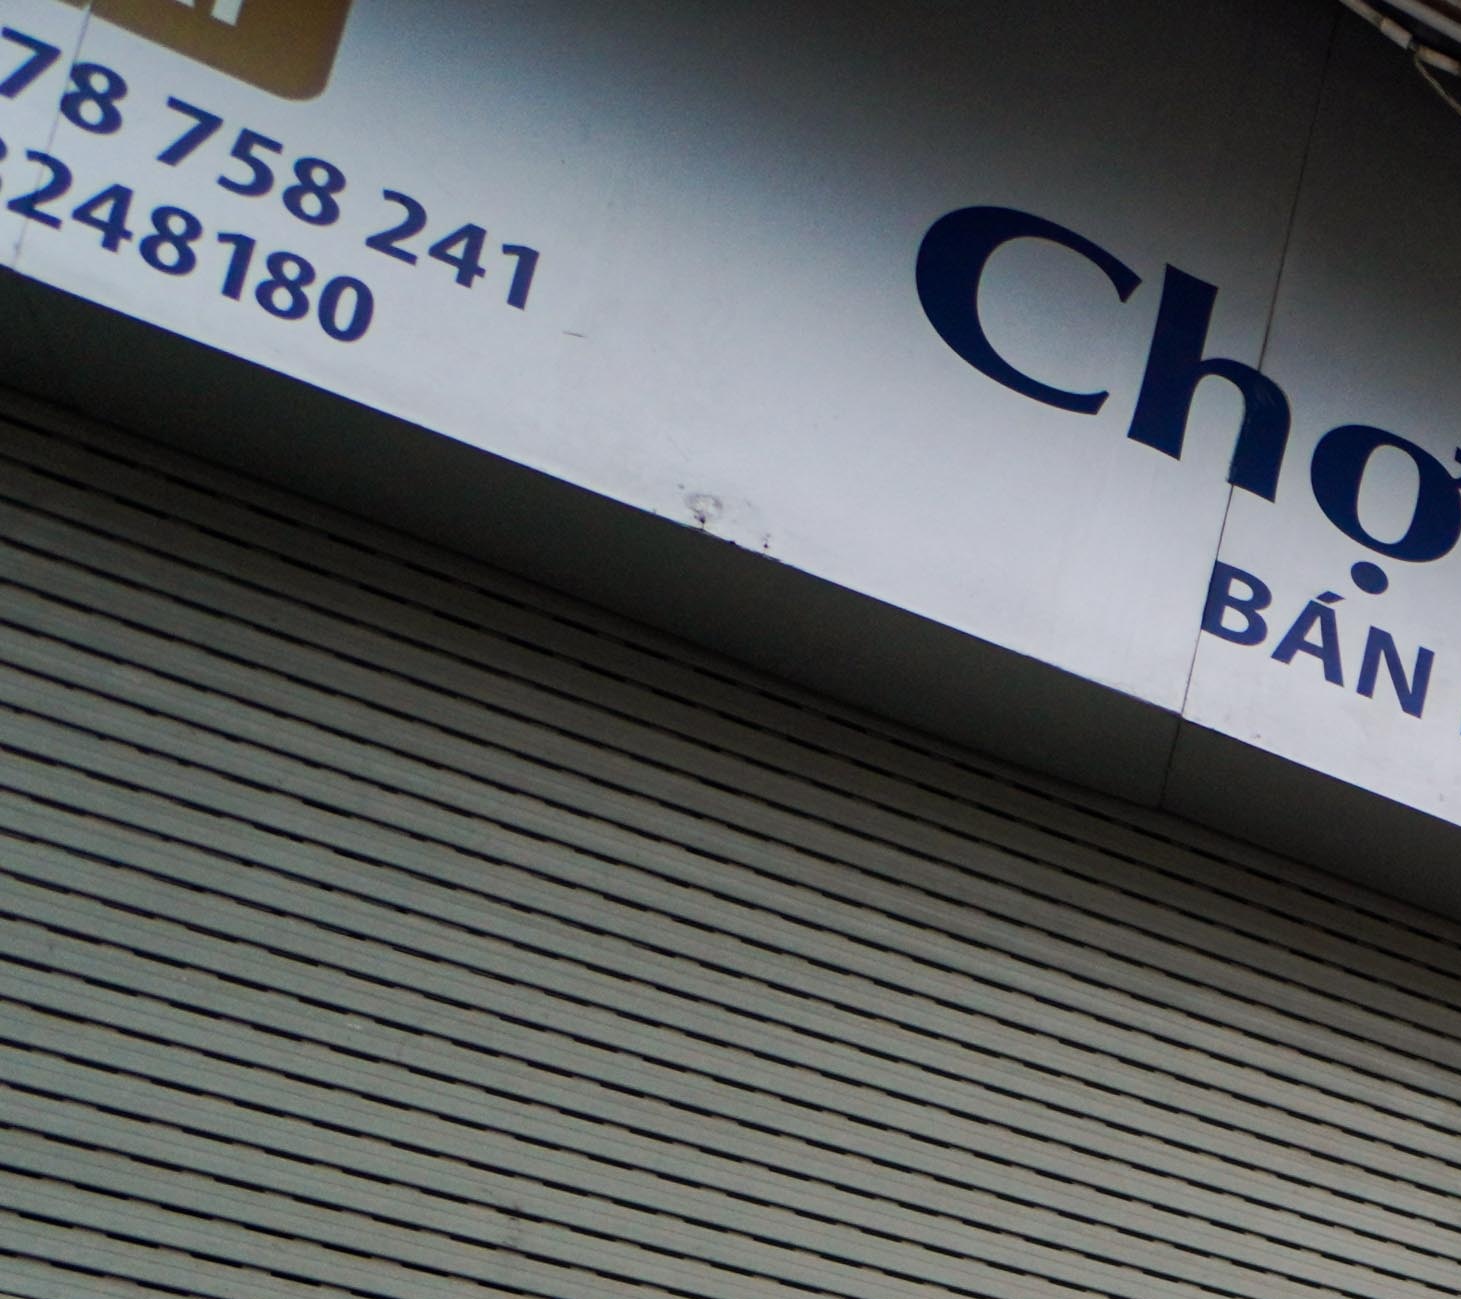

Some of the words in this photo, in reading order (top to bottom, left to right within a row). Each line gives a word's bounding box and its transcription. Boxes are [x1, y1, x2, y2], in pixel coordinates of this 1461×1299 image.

[0, 27, 128, 134] 78
[155, 97, 346, 227] 758
[366, 188, 541, 310] 241
[0, 139, 375, 342] 248180
[1199, 561, 1435, 720] BÁN
